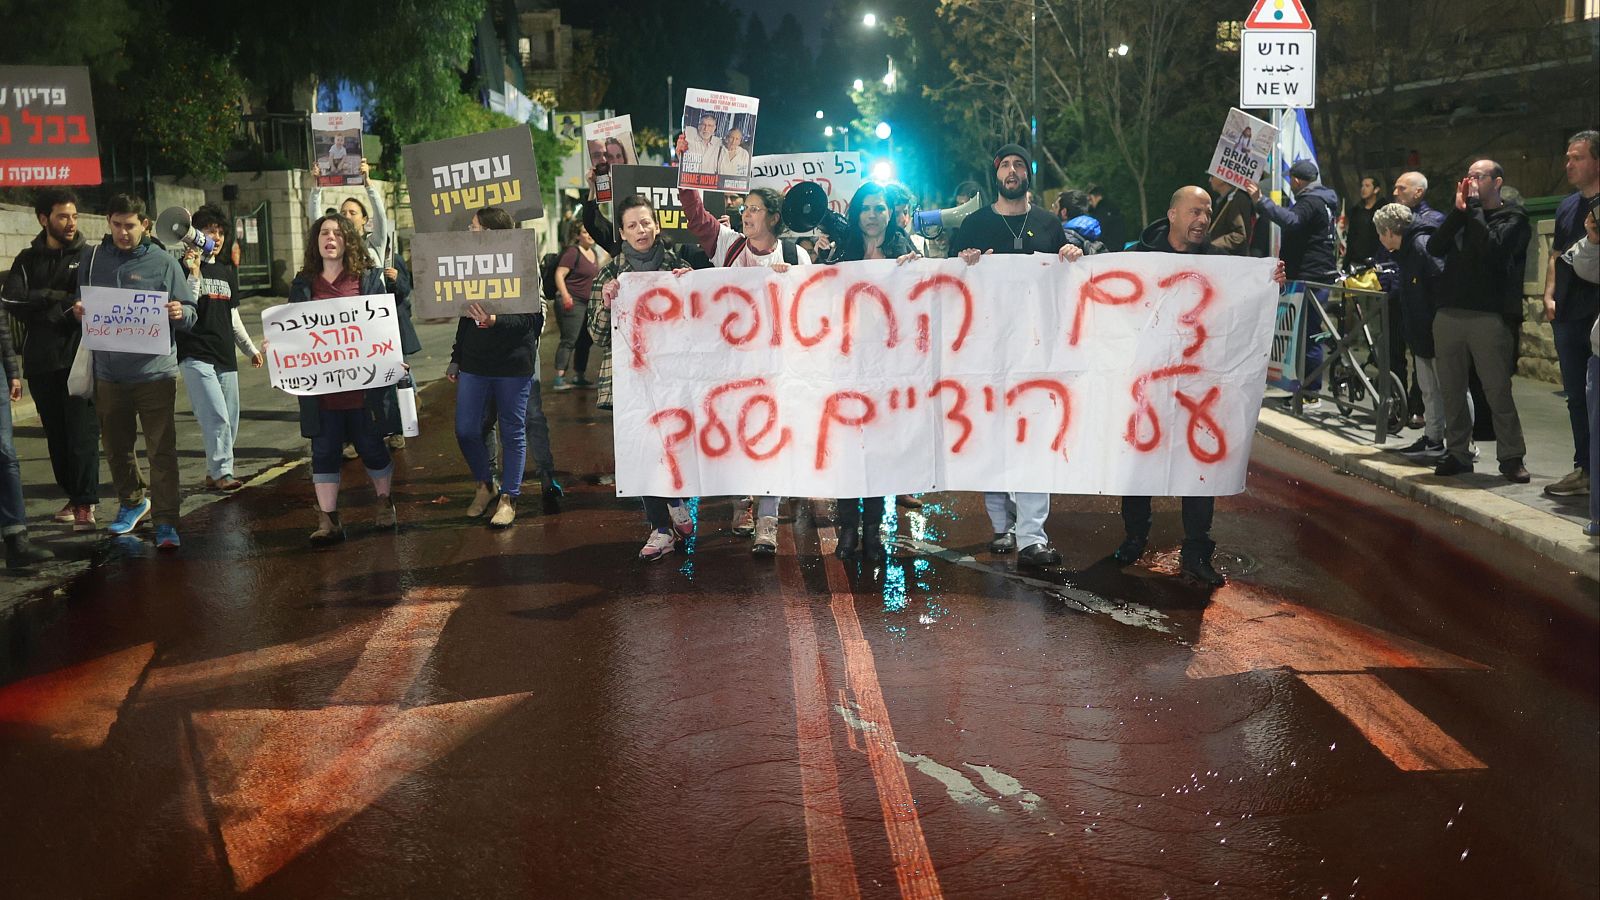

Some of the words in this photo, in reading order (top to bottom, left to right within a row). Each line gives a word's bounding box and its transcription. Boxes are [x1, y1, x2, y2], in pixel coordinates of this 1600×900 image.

[1258, 42, 1299, 56] חדש
[1261, 64, 1295, 76] جديد
[13, 87, 66, 108] פדיון
[1257, 82, 1299, 95] NEW
[22, 108, 90, 144] בכל
[834, 154, 856, 174] כל
[1220, 156, 1255, 179] HERSH
[1223, 147, 1258, 170] BRING
[8, 166, 70, 183] #עסקה
[432, 154, 511, 189] עסקה
[680, 173, 700, 184] HOME
[1215, 165, 1250, 187] HOME
[431, 179, 521, 216] עכשיו!
[438, 253, 513, 279] עסקה
[133, 293, 161, 304] דם
[434, 278, 521, 301] עכשיו!
[365, 300, 390, 320] כל
[631, 267, 973, 370] החטופים
[1069, 269, 1214, 357] דם
[308, 325, 363, 349] הורג
[366, 339, 394, 358] את
[273, 347, 360, 374] החטופים!
[815, 379, 1071, 470] הידיים
[1125, 364, 1227, 463] על
[650, 378, 793, 490] שלך
